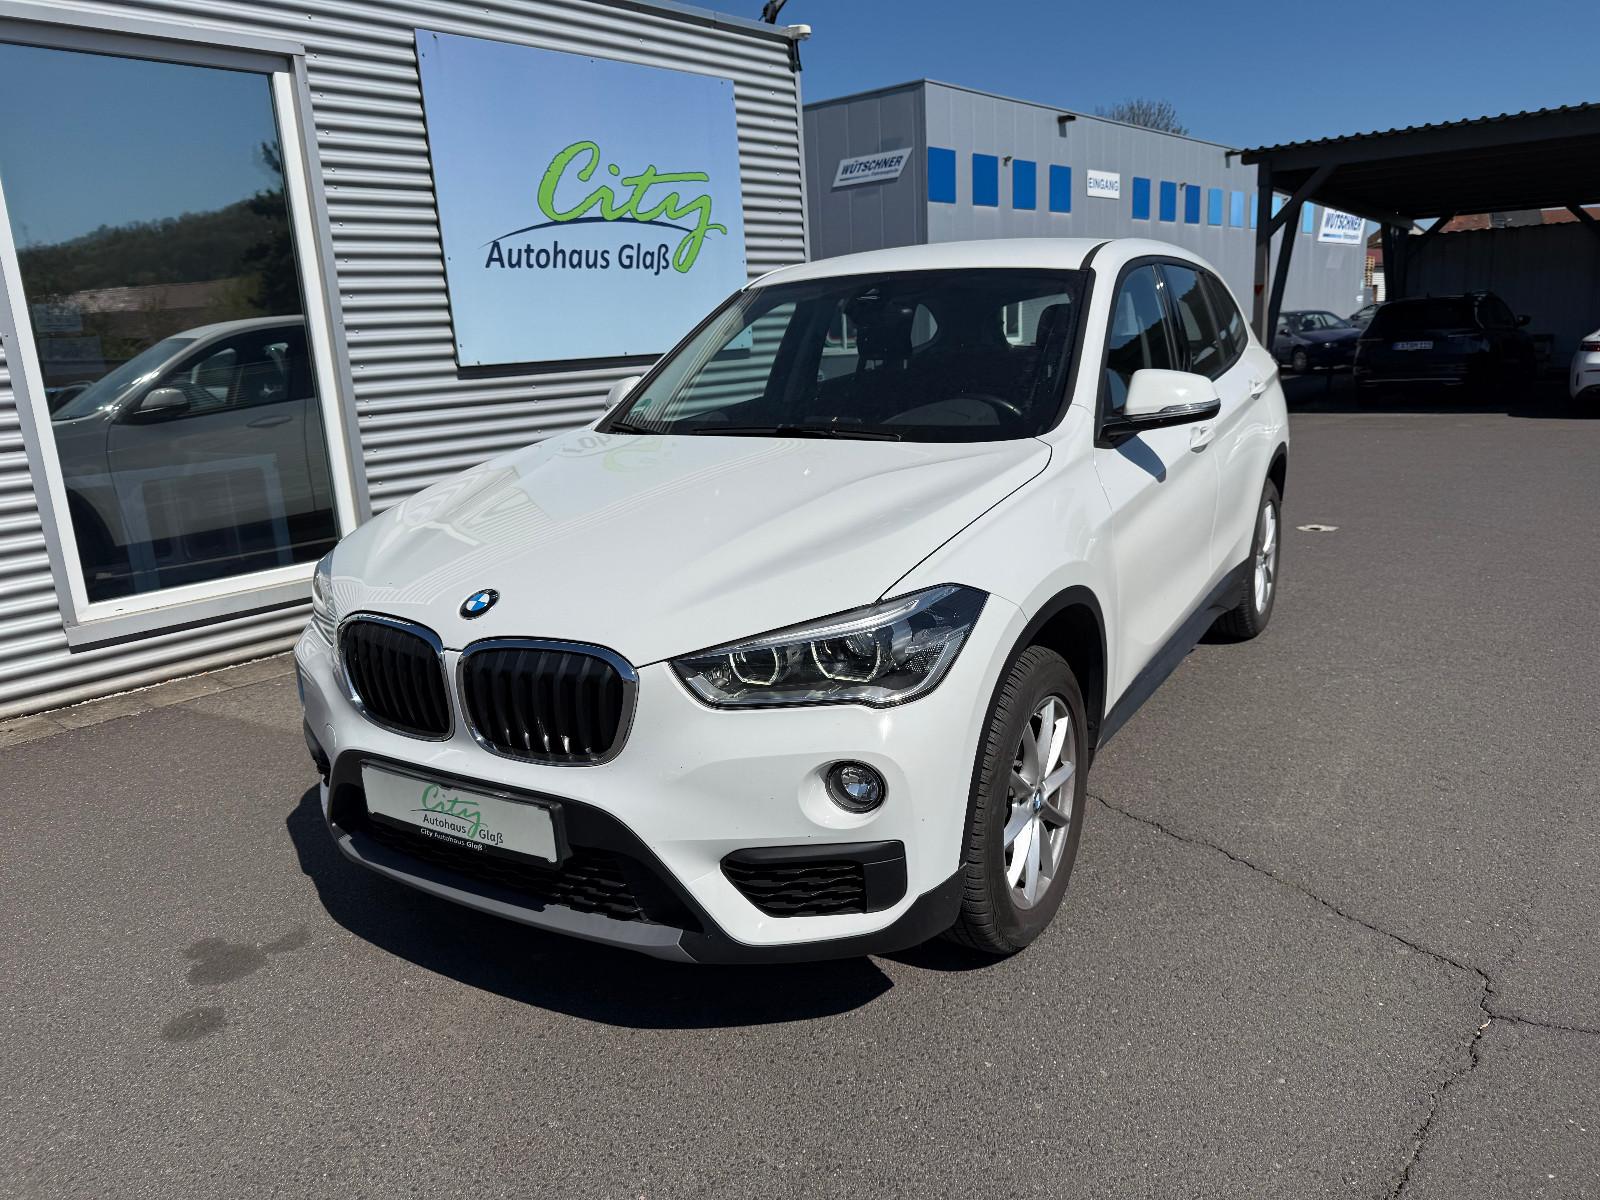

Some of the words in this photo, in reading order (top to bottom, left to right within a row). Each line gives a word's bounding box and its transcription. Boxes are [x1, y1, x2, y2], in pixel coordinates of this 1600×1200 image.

[841, 155, 904, 176] WÜTSCHNER
[1088, 177, 1119, 192] EINGANG
[537, 140, 728, 273] City
[485, 241, 610, 271] Autohaus
[618, 243, 670, 276] Glaß
[421, 783, 489, 840] City
[420, 828, 433, 838] City
[434, 832, 465, 846] Autohaus
[466, 841, 484, 851] Glaß
[423, 813, 467, 834] Autohaus
[478, 829, 504, 844] Glaß
